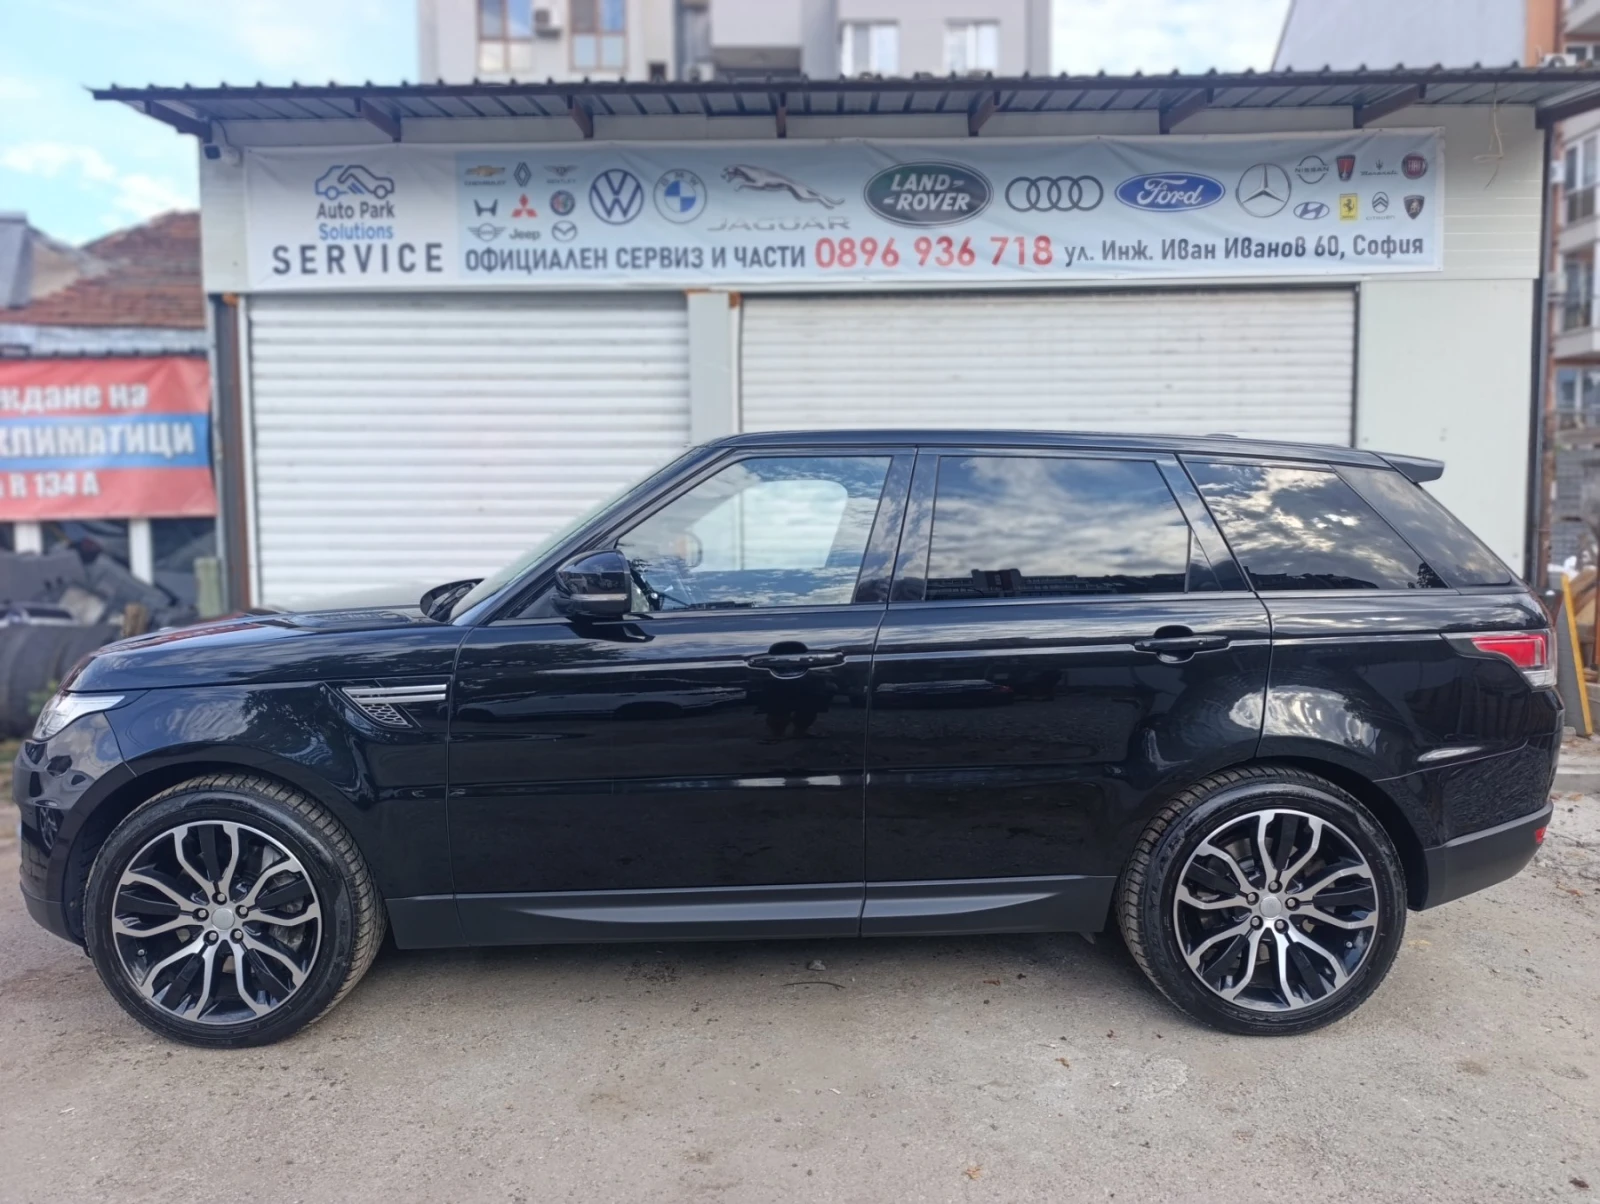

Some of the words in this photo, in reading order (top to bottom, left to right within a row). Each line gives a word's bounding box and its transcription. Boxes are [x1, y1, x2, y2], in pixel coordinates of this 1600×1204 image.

[1136, 178, 1204, 205] Ford
[317, 203, 354, 219] Auto
[360, 201, 395, 218] Park
[319, 223, 393, 240] Solutions
[509, 230, 541, 241] Jeep
[707, 217, 850, 231] JAGUAR
[272, 243, 443, 275] SERVICE
[465, 248, 608, 274] ОФИЦИАЛЕН
[616, 247, 704, 269] СЕРВИЗ
[712, 247, 726, 268] И
[734, 246, 806, 268] ЧАСТИ
[815, 237, 900, 268] 0896
[914, 236, 976, 267] 936
[990, 236, 1053, 266] 718
[1065, 246, 1094, 267] ул.
[1102, 240, 1153, 261] Инж.
[1162, 239, 1216, 260] Иван
[1224, 237, 1306, 259] Иванов
[1314, 235, 1345, 260] 60,
[1353, 234, 1423, 259] София
[109, 384, 148, 409] на
[35, 472, 76, 497] 134
